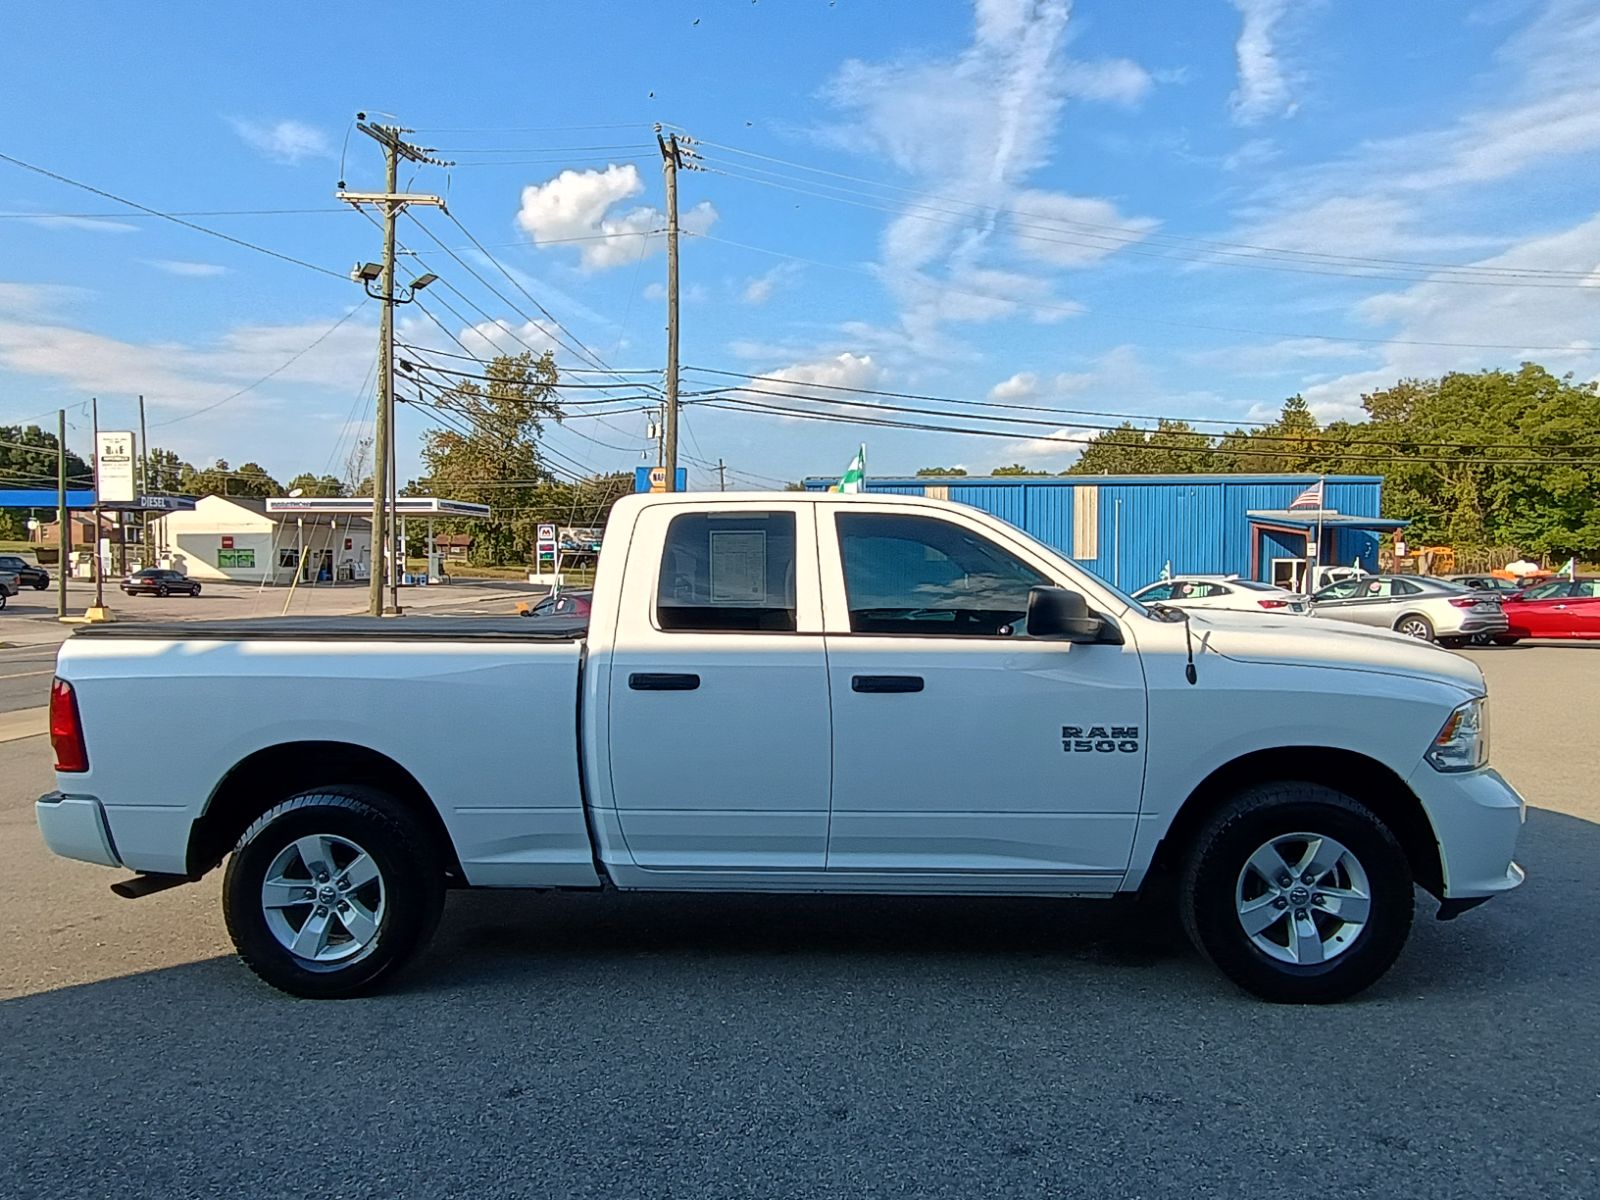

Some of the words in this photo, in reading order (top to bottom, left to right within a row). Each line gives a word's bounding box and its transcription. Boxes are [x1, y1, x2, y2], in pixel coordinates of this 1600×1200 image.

[653, 473, 665, 481] NAP
[141, 496, 166, 508] DIESEL
[1062, 726, 1138, 738] RAM
[1062, 740, 1138, 753] 1500
